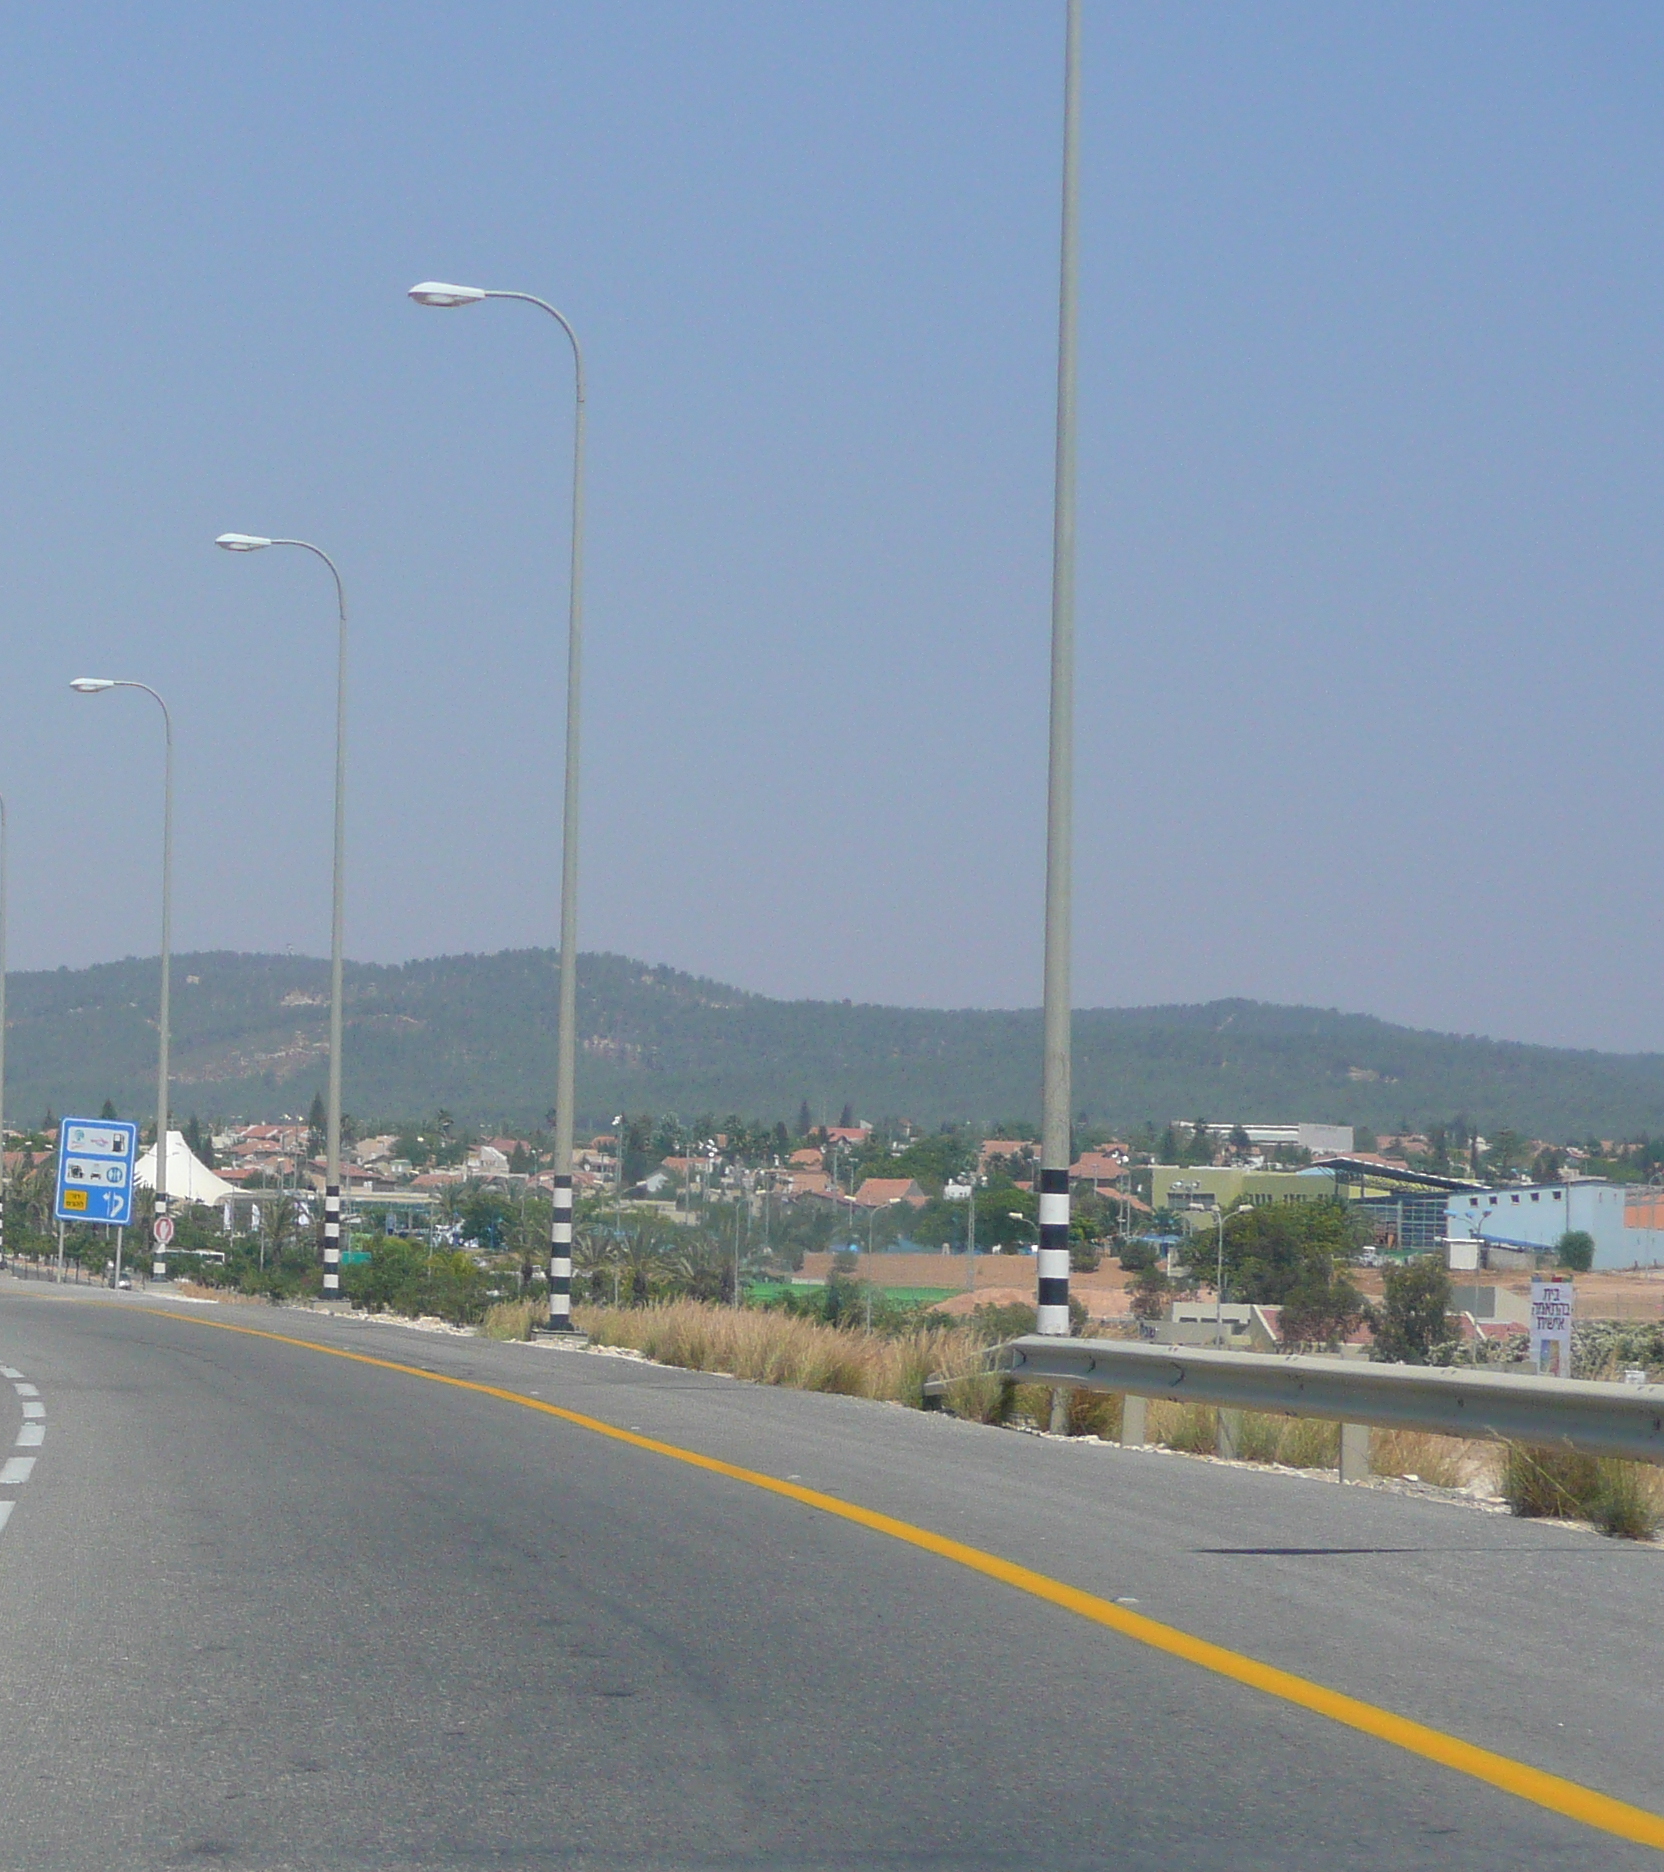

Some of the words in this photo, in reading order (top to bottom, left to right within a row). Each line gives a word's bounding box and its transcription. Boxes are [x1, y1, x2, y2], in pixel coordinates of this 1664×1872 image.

[1542, 1288, 1560, 1301] בית
[1531, 1302, 1570, 1316] בהתאמה
[1536, 1316, 1565, 1330] אישית
